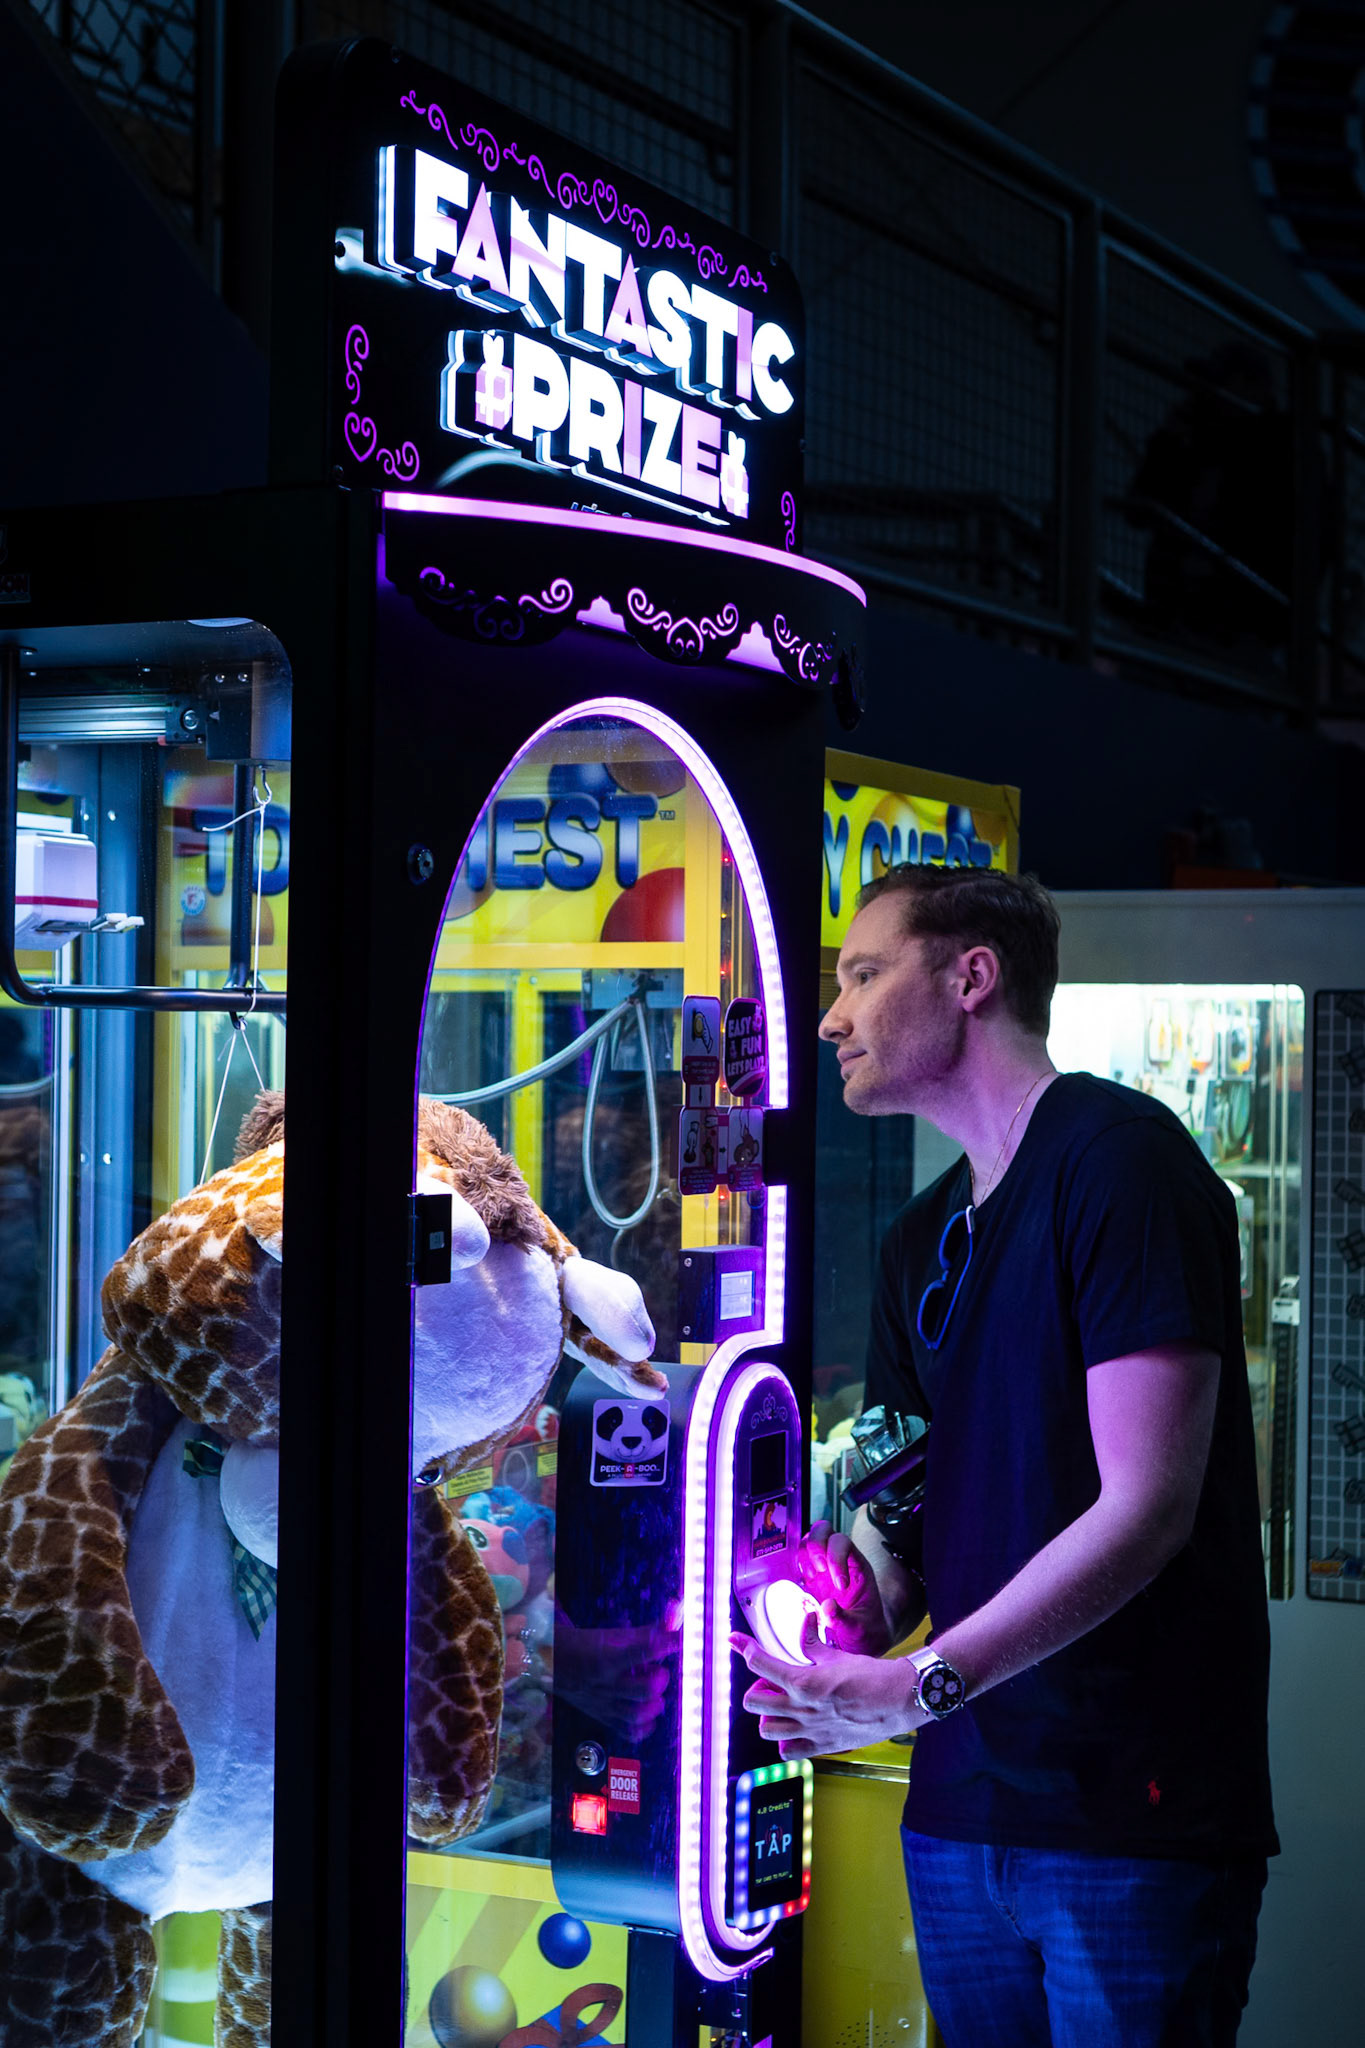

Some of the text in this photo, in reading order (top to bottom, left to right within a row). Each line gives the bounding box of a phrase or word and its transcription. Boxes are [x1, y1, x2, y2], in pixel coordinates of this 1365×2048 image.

[413, 148, 796, 415] FANTASTIC
[512, 331, 722, 509] PRIZE
[727, 1016, 752, 1038] EASY
[741, 1035, 762, 1056] FUN
[610, 1776, 639, 1792] DOOR
[610, 1790, 640, 1802] RELEASE
[754, 1832, 793, 1860] TAP
